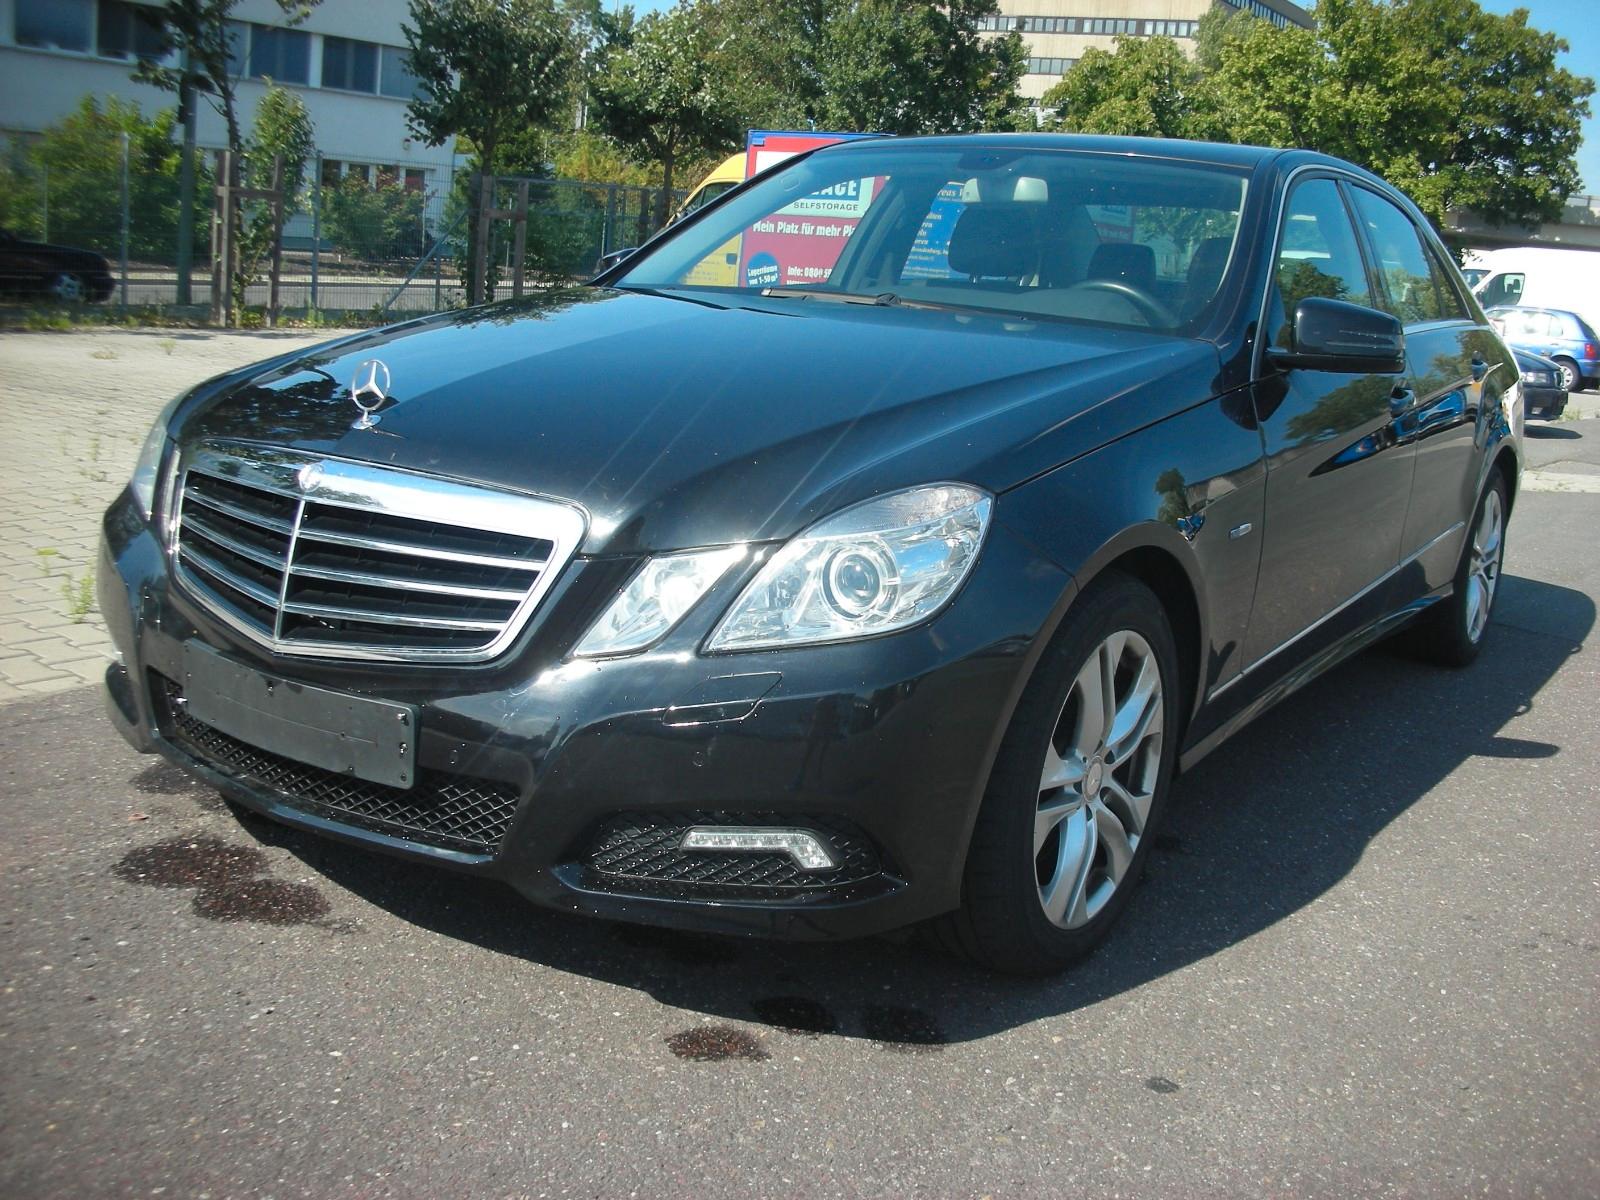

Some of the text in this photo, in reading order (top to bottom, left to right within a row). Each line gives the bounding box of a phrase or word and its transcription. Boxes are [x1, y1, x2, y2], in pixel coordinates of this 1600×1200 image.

[793, 202, 859, 212] SELFSTORAGE
[752, 220, 775, 233] Mein
[777, 221, 799, 234] Platz
[801, 222, 815, 235] für
[816, 224, 841, 237] mehr
[787, 265, 803, 276] Info:
